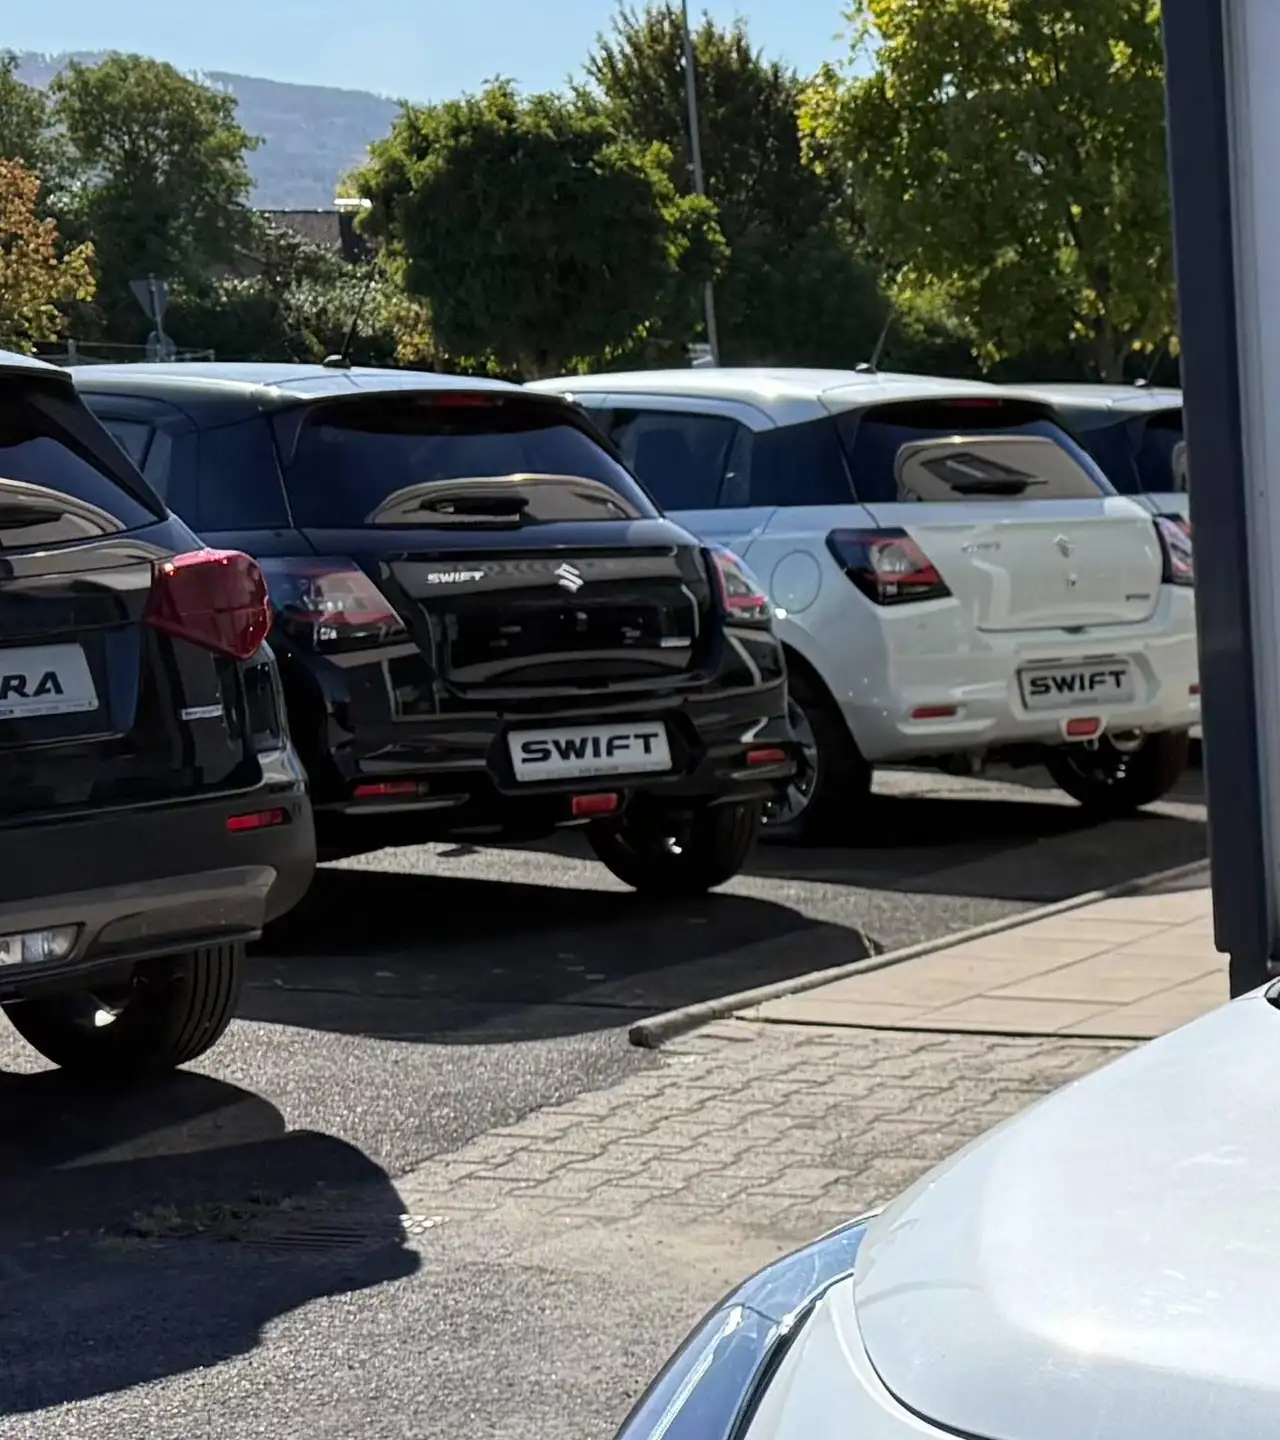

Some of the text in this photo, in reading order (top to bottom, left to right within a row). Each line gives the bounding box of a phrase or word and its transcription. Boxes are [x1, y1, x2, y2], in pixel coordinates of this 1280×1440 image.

[426, 570, 486, 584] SWIFT
[1029, 669, 1127, 697] SWIFT
[520, 732, 661, 765] SWIFT
